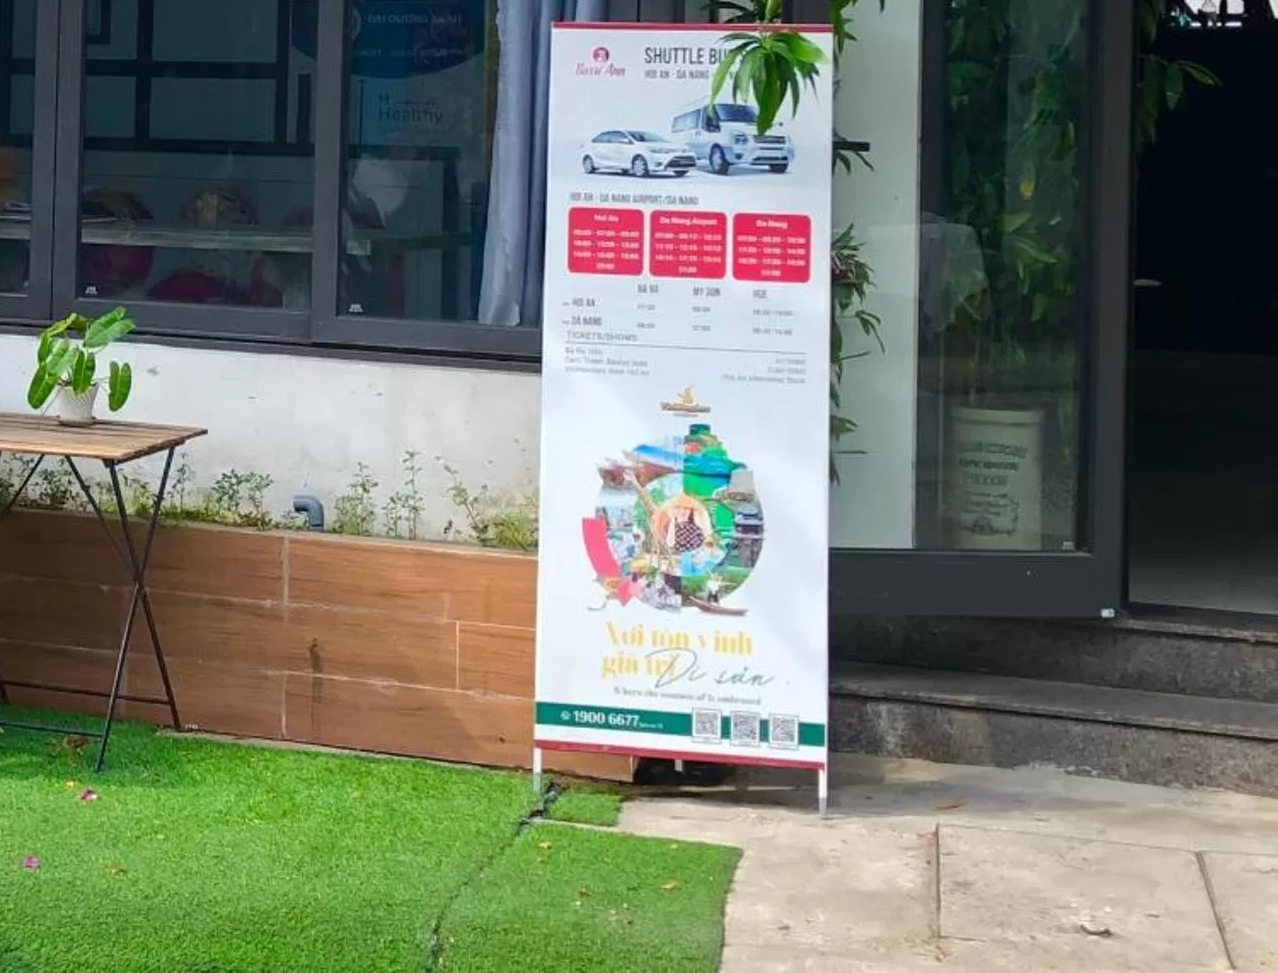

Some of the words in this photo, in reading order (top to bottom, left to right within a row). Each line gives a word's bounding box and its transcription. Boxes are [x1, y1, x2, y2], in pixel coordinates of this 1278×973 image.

[644, 47, 704, 65] SHUTTLE
[573, 709, 606, 725] 1900
[608, 712, 640, 728] 6677
